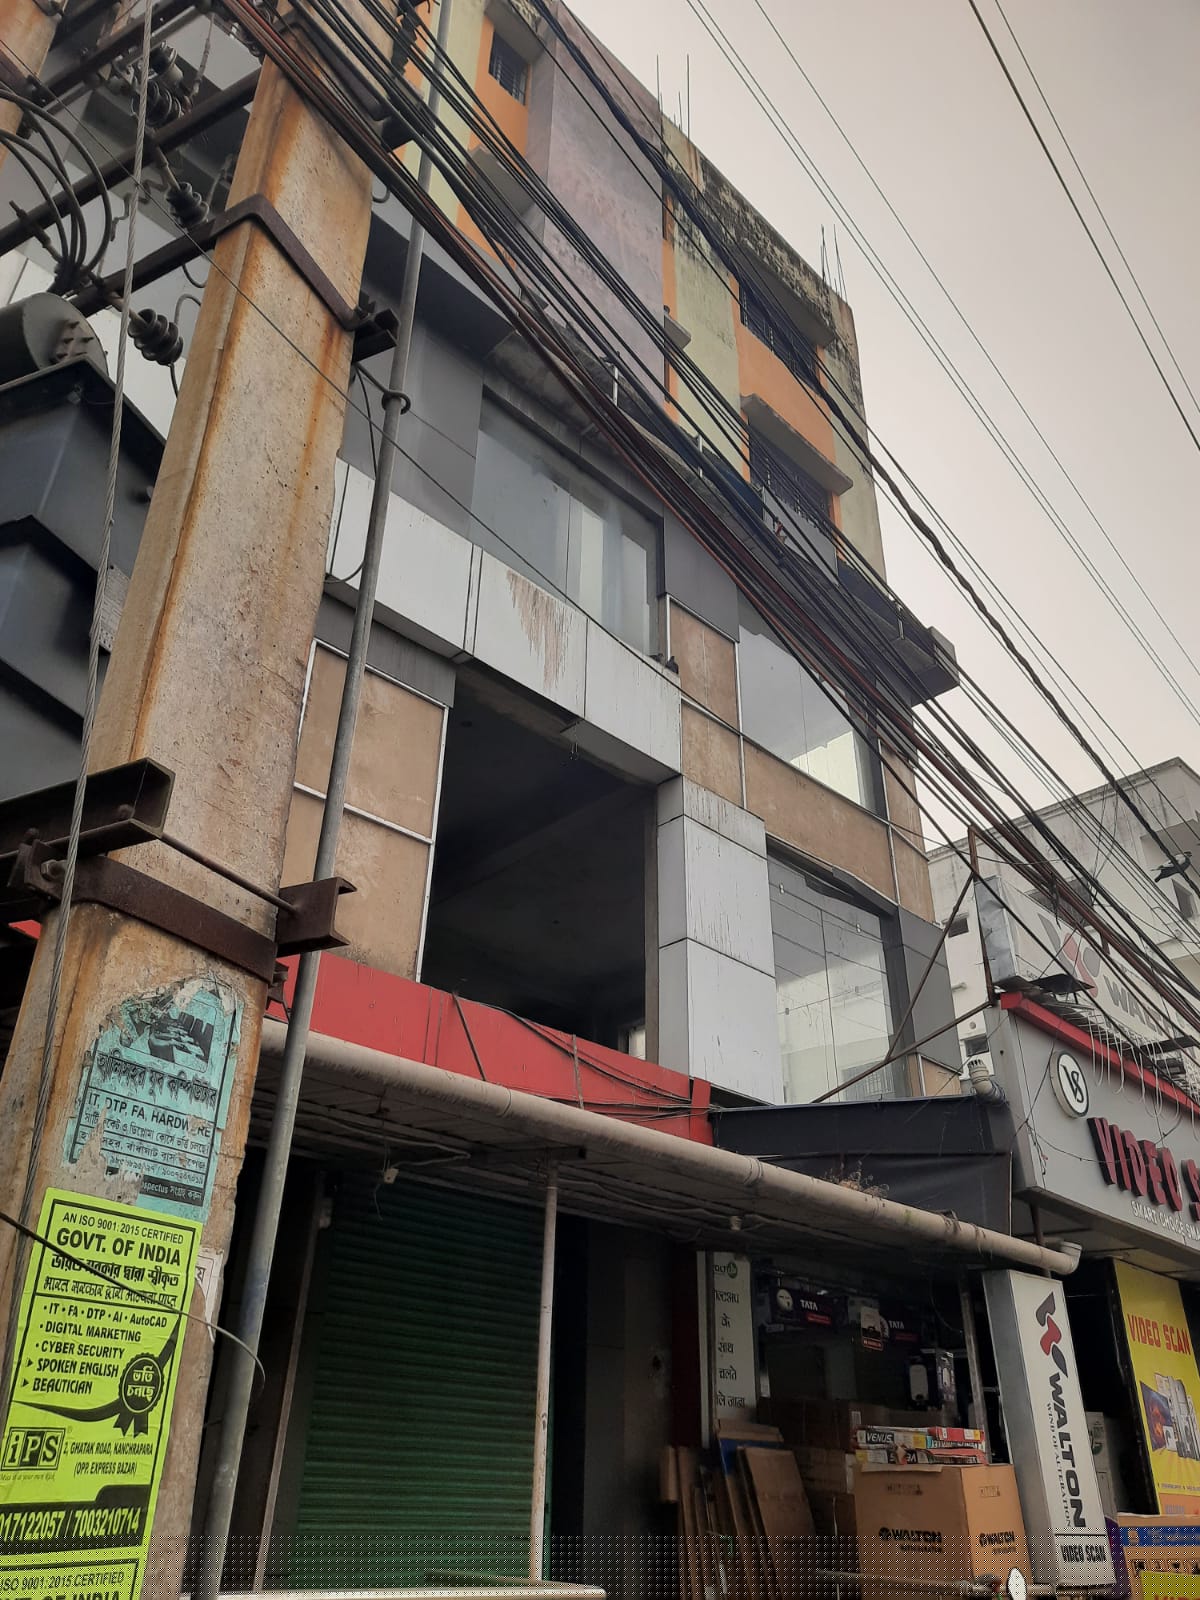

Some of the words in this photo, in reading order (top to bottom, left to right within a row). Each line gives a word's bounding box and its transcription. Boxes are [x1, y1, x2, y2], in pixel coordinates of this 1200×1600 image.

[151, 1108, 212, 1138] HARDWRE
[1087, 1117, 1183, 1212] VIDEO
[1131, 1200, 1158, 1225] SMART
[62, 1211, 77, 1224] AN
[79, 1214, 96, 1228] ISO
[141, 1227, 184, 1245] CERTIFIED
[56, 1227, 106, 1253] GOVT.
[112, 1237, 135, 1257] OF
[138, 1242, 181, 1266] INDIA
[49, 1303, 60, 1315] IT
[68, 1306, 78, 1317] FA
[86, 1307, 106, 1320] DTP
[113, 1311, 122, 1323] AI
[129, 1313, 168, 1328] AutoCAD
[45, 1321, 83, 1337] DIGITAL
[86, 1325, 142, 1343] MARKETING
[1127, 1313, 1162, 1348] VIDEO
[1163, 1324, 1192, 1356] SCAN
[41, 1340, 75, 1354] CYBER
[77, 1343, 125, 1359] SECURITY
[37, 1358, 76, 1375] SPOKEN
[79, 1361, 119, 1378] ENGLISH
[32, 1378, 93, 1395] BEAUTICIAN
[866, 1432, 893, 1444] VENUS
[1049, 1372, 1087, 1528] WALTON
[90, 1461, 116, 1475] EXPRESS
[73, 1507, 141, 1537] 7003210714
[891, 1529, 943, 1545] WALTON
[1061, 1544, 1084, 1563] VIDEO
[1085, 1545, 1107, 1562] SCAN
[74, 1571, 125, 1588] CERTIFIED
